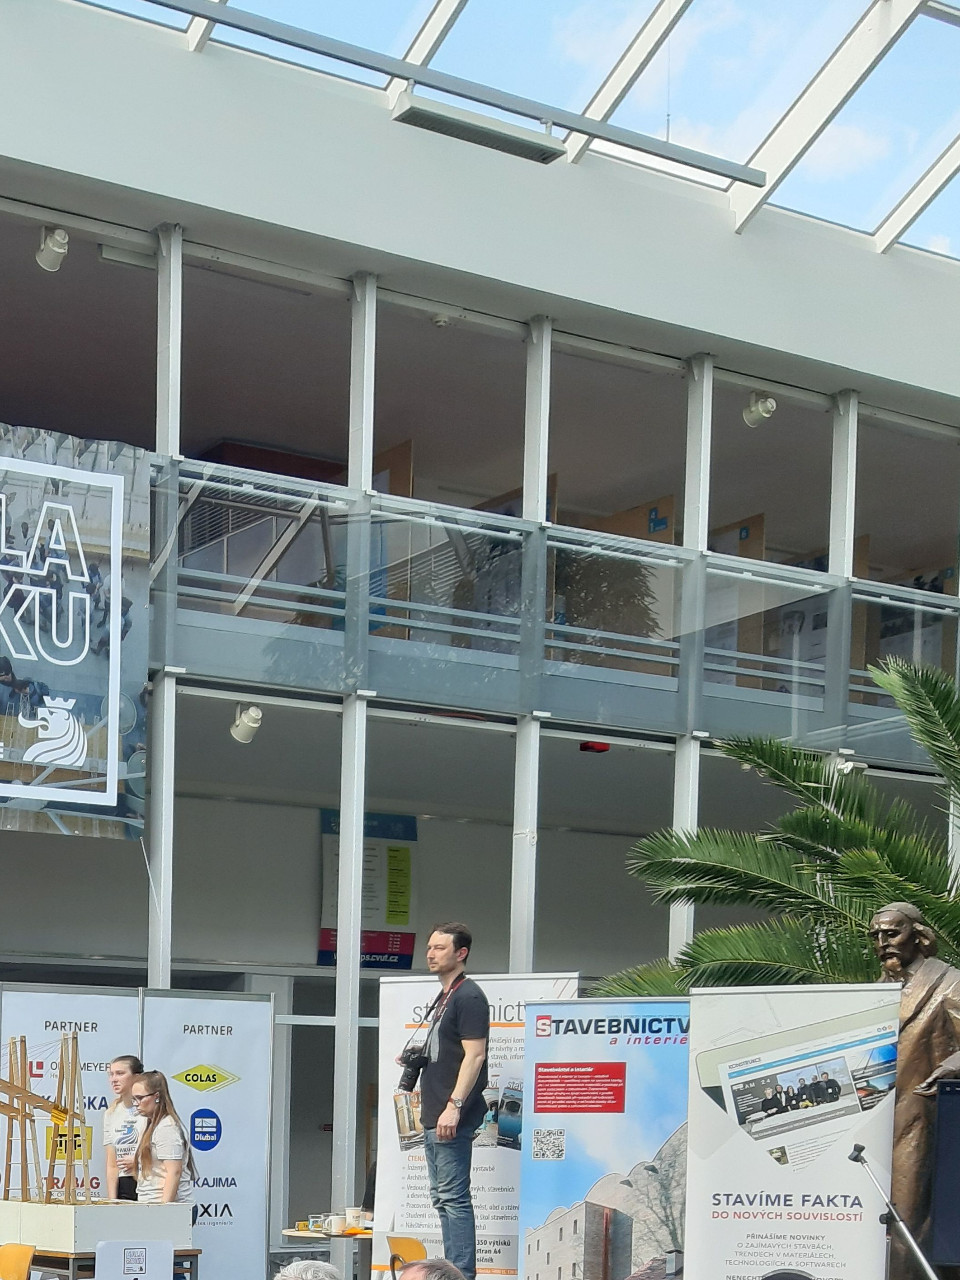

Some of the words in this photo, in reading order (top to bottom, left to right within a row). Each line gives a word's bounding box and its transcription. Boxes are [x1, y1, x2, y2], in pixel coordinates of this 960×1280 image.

[44, 1020, 98, 1032] PARTNER
[183, 1024, 233, 1036] PARTNER
[537, 1017, 690, 1036] STAVEBNICTV
[609, 1037, 618, 1045] a
[626, 1034, 688, 1045] interié
[184, 1073, 217, 1082] COLAS
[195, 1133, 217, 1141] Dlubal
[193, 1177, 237, 1188] KAJIMA
[712, 1190, 793, 1207] STAVÍME
[801, 1194, 863, 1208] FAKTA
[712, 1210, 729, 1220] DO
[733, 1209, 783, 1220] NOVÝCH
[786, 1211, 863, 1222] SOUVISLOSTÍ
[746, 1232, 787, 1240] PŘINÁŠÍME
